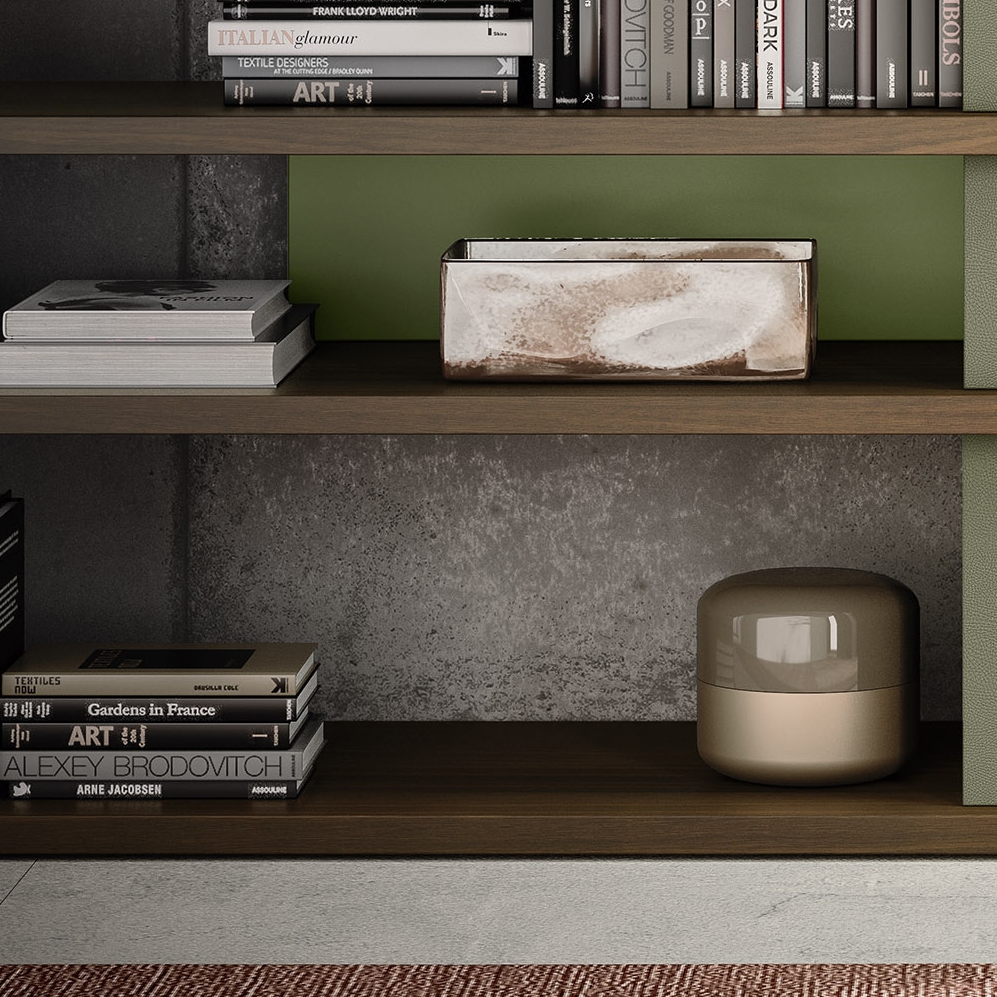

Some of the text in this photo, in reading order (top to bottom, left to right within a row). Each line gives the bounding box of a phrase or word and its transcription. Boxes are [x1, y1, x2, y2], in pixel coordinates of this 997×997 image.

[313, 6, 418, 16] FRANK LLOYD WRIGHT
[663, 5, 675, 55] GOODMAN
[763, 0, 778, 52] DARK
[217, 29, 358, 50] ITALIAN glamour
[238, 57, 329, 68] TEXTILE DESIGNERS
[766, 61, 774, 100] ASSOULINE
[292, 82, 340, 102] ART
[15, 676, 61, 685] TEXTILES
[14, 685, 36, 694] NOW
[87, 703, 216, 716] Gardens in France
[68, 725, 114, 746] ART
[3, 755, 282, 777] ALEXEY BRODOVITCH
[76, 784, 162, 795] ARNE JACOBSEN
[251, 786, 287, 794] ASSOULINE
